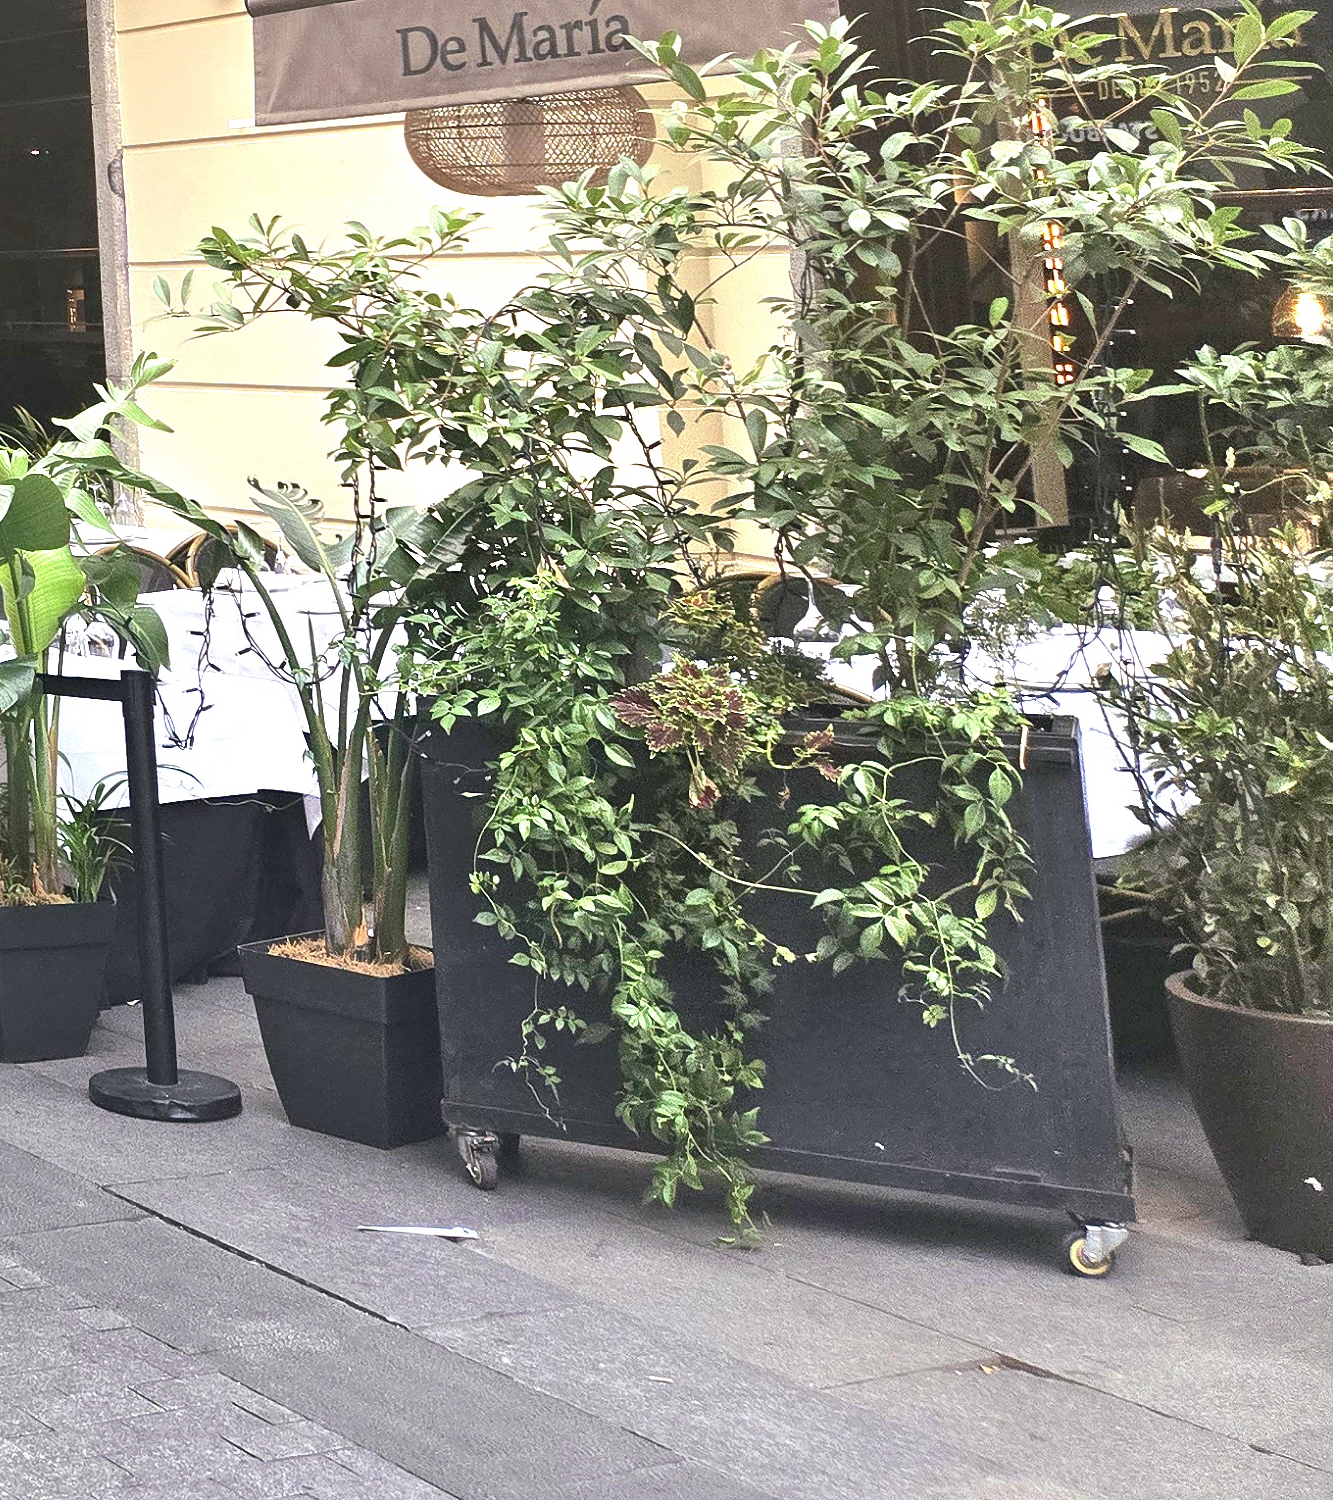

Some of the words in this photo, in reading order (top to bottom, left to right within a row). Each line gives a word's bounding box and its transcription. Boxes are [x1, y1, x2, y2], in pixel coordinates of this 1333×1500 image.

[396, 25, 467, 77] De
[472, 0, 633, 68] María
[1114, 0, 1308, 62] Mar
